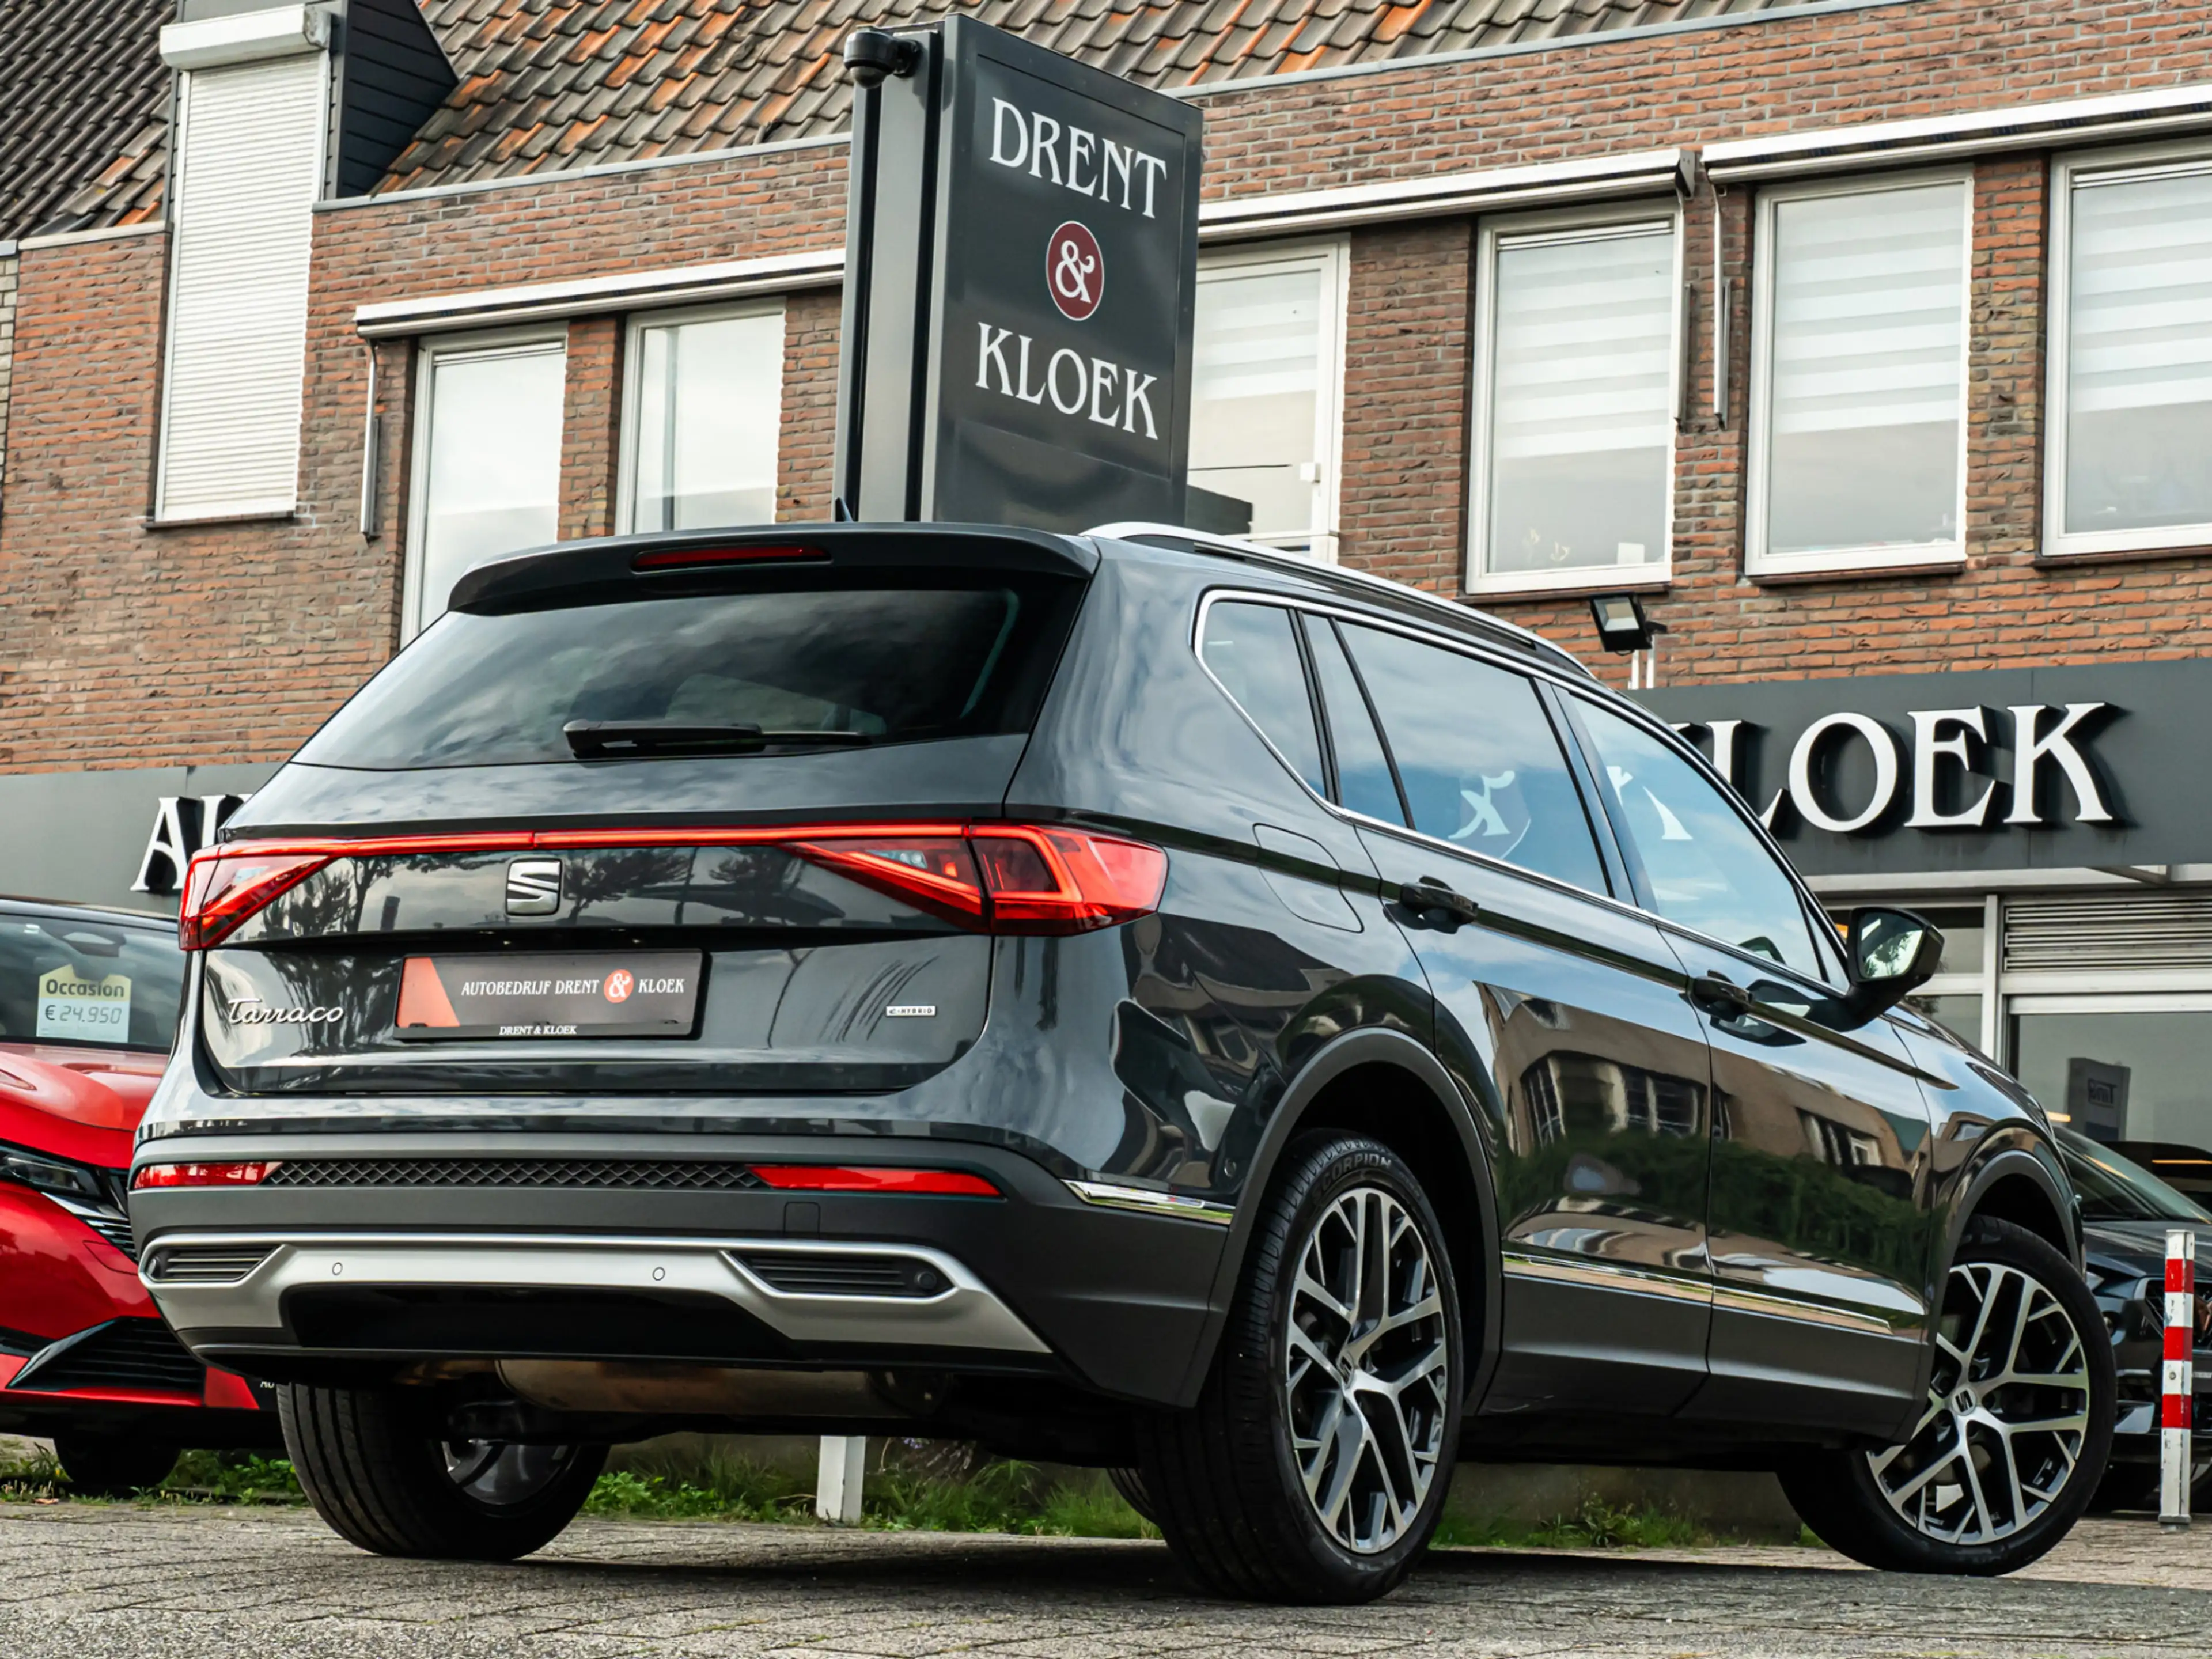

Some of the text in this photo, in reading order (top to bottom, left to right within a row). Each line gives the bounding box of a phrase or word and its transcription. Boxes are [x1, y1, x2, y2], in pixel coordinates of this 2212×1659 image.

[989, 97, 1168, 219] DRENT
[1055, 240, 1096, 304] &
[975, 321, 1158, 440] KLOEK
[46, 979, 124, 997] Occasion
[461, 972, 685, 998] AUTOBEDRIJF DRENT & KLOEK
[45, 1004, 123, 1024] € 24.950
[228, 998, 344, 1023] Tarraco
[499, 1025, 578, 1035] DRENT & KLOEK
